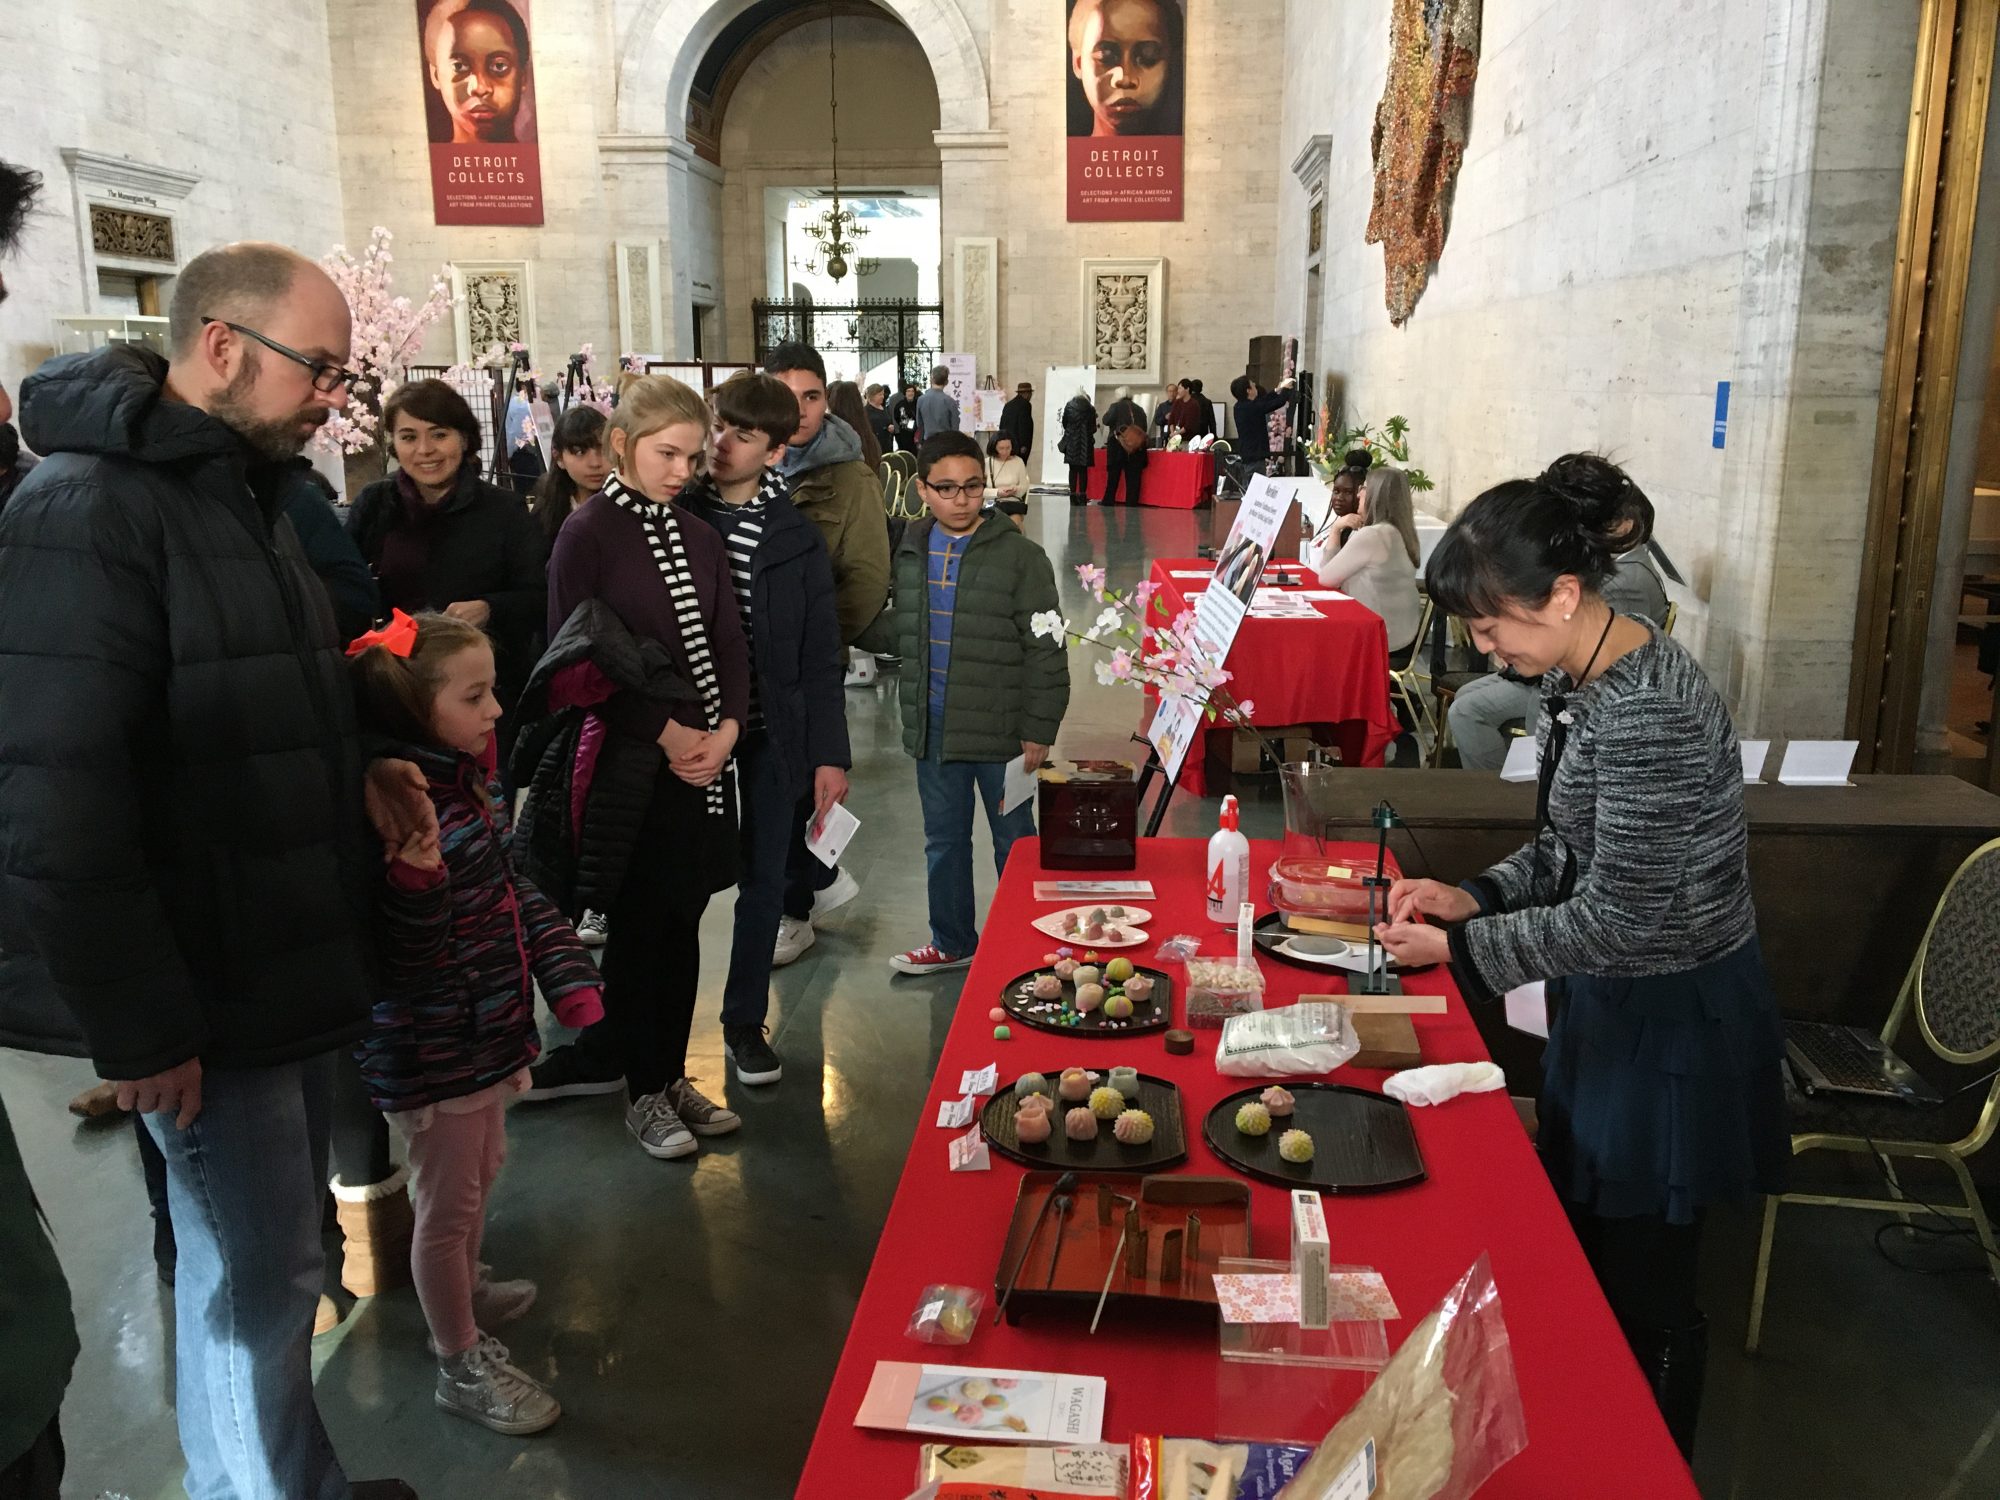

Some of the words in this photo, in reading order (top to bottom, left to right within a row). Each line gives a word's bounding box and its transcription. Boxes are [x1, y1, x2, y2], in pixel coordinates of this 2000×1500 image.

[453, 156, 518, 168] DETROIT
[1091, 150, 1158, 162] DETROIT
[448, 172, 525, 183] COLLECTS
[1084, 166, 1164, 178] COLLECTS
[1066, 1386, 1085, 1434] WAGASHI
[1278, 1450, 1296, 1477] Agar
[1265, 1458, 1277, 1490] Vegetable
